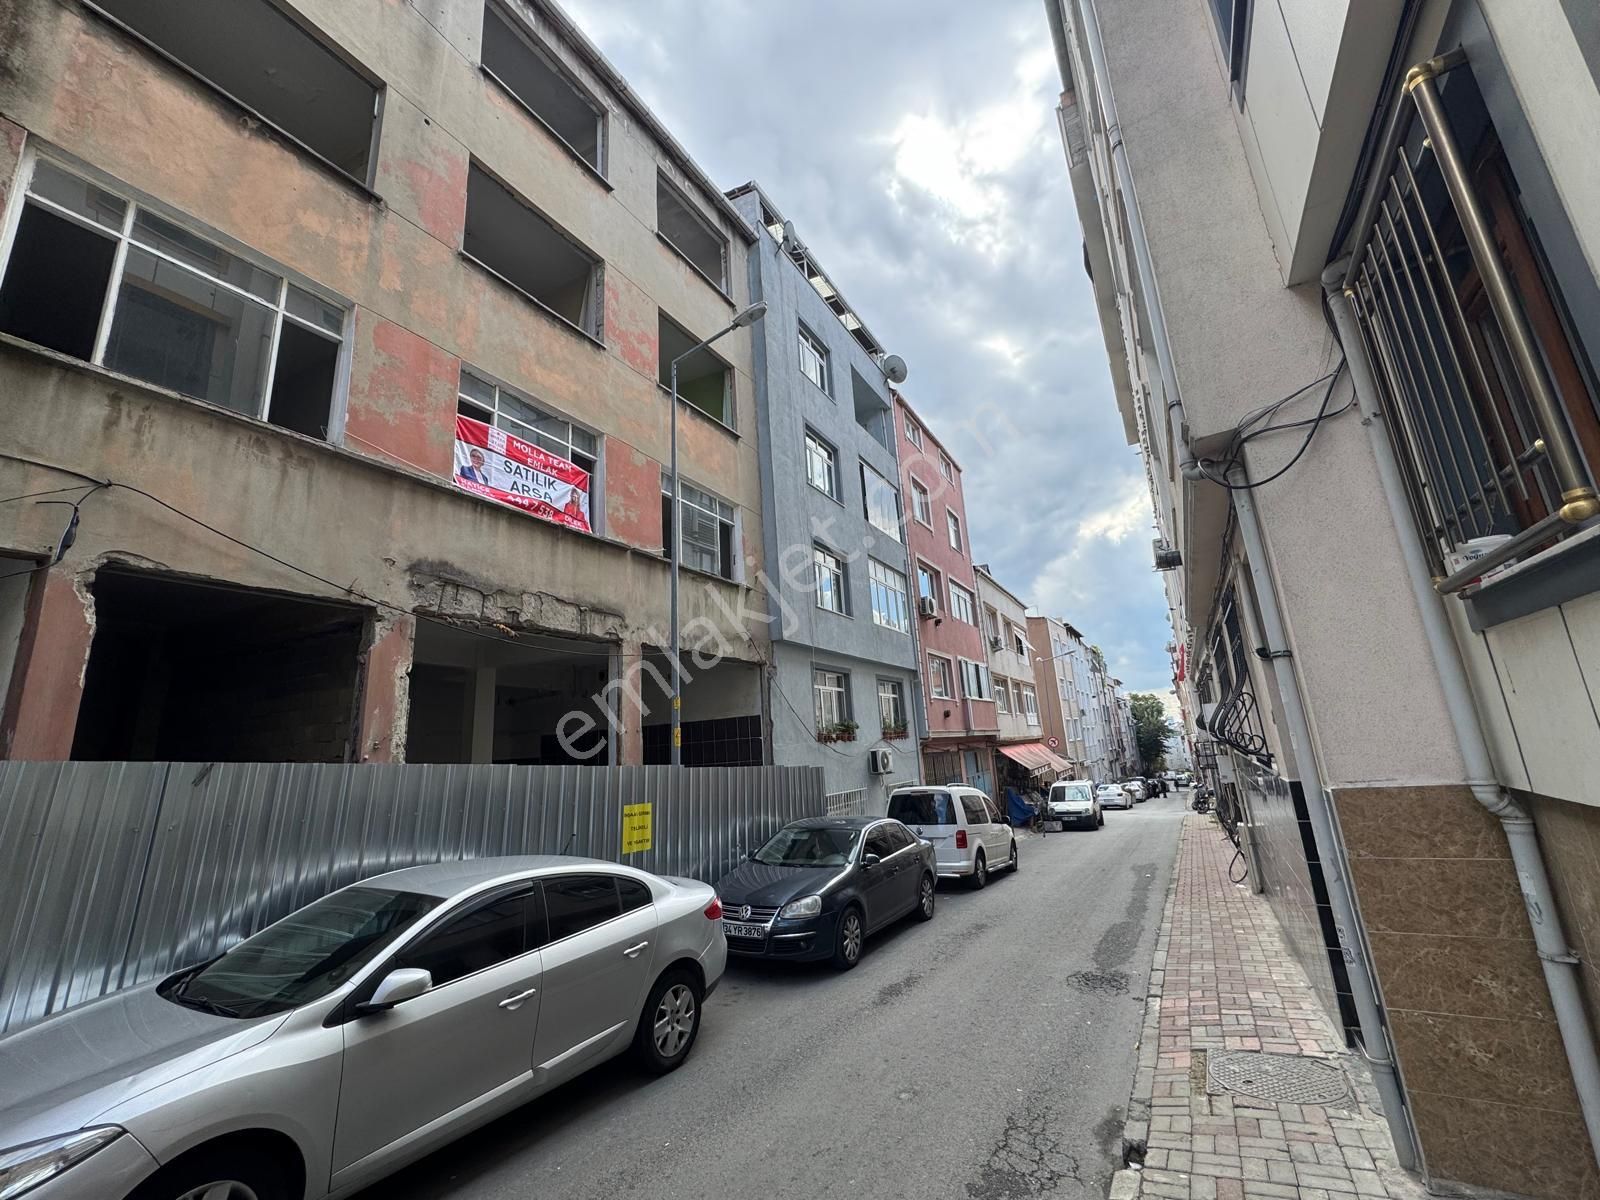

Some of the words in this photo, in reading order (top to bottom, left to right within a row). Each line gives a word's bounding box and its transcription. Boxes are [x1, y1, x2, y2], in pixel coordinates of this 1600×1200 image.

[513, 440, 546, 462] MOLLA
[547, 456, 573, 473] TEAM
[503, 460, 558, 492] SATILIK
[510, 480, 553, 504] ARSA
[733, 926, 743, 936] YR
[743, 927, 761, 937] 3876
